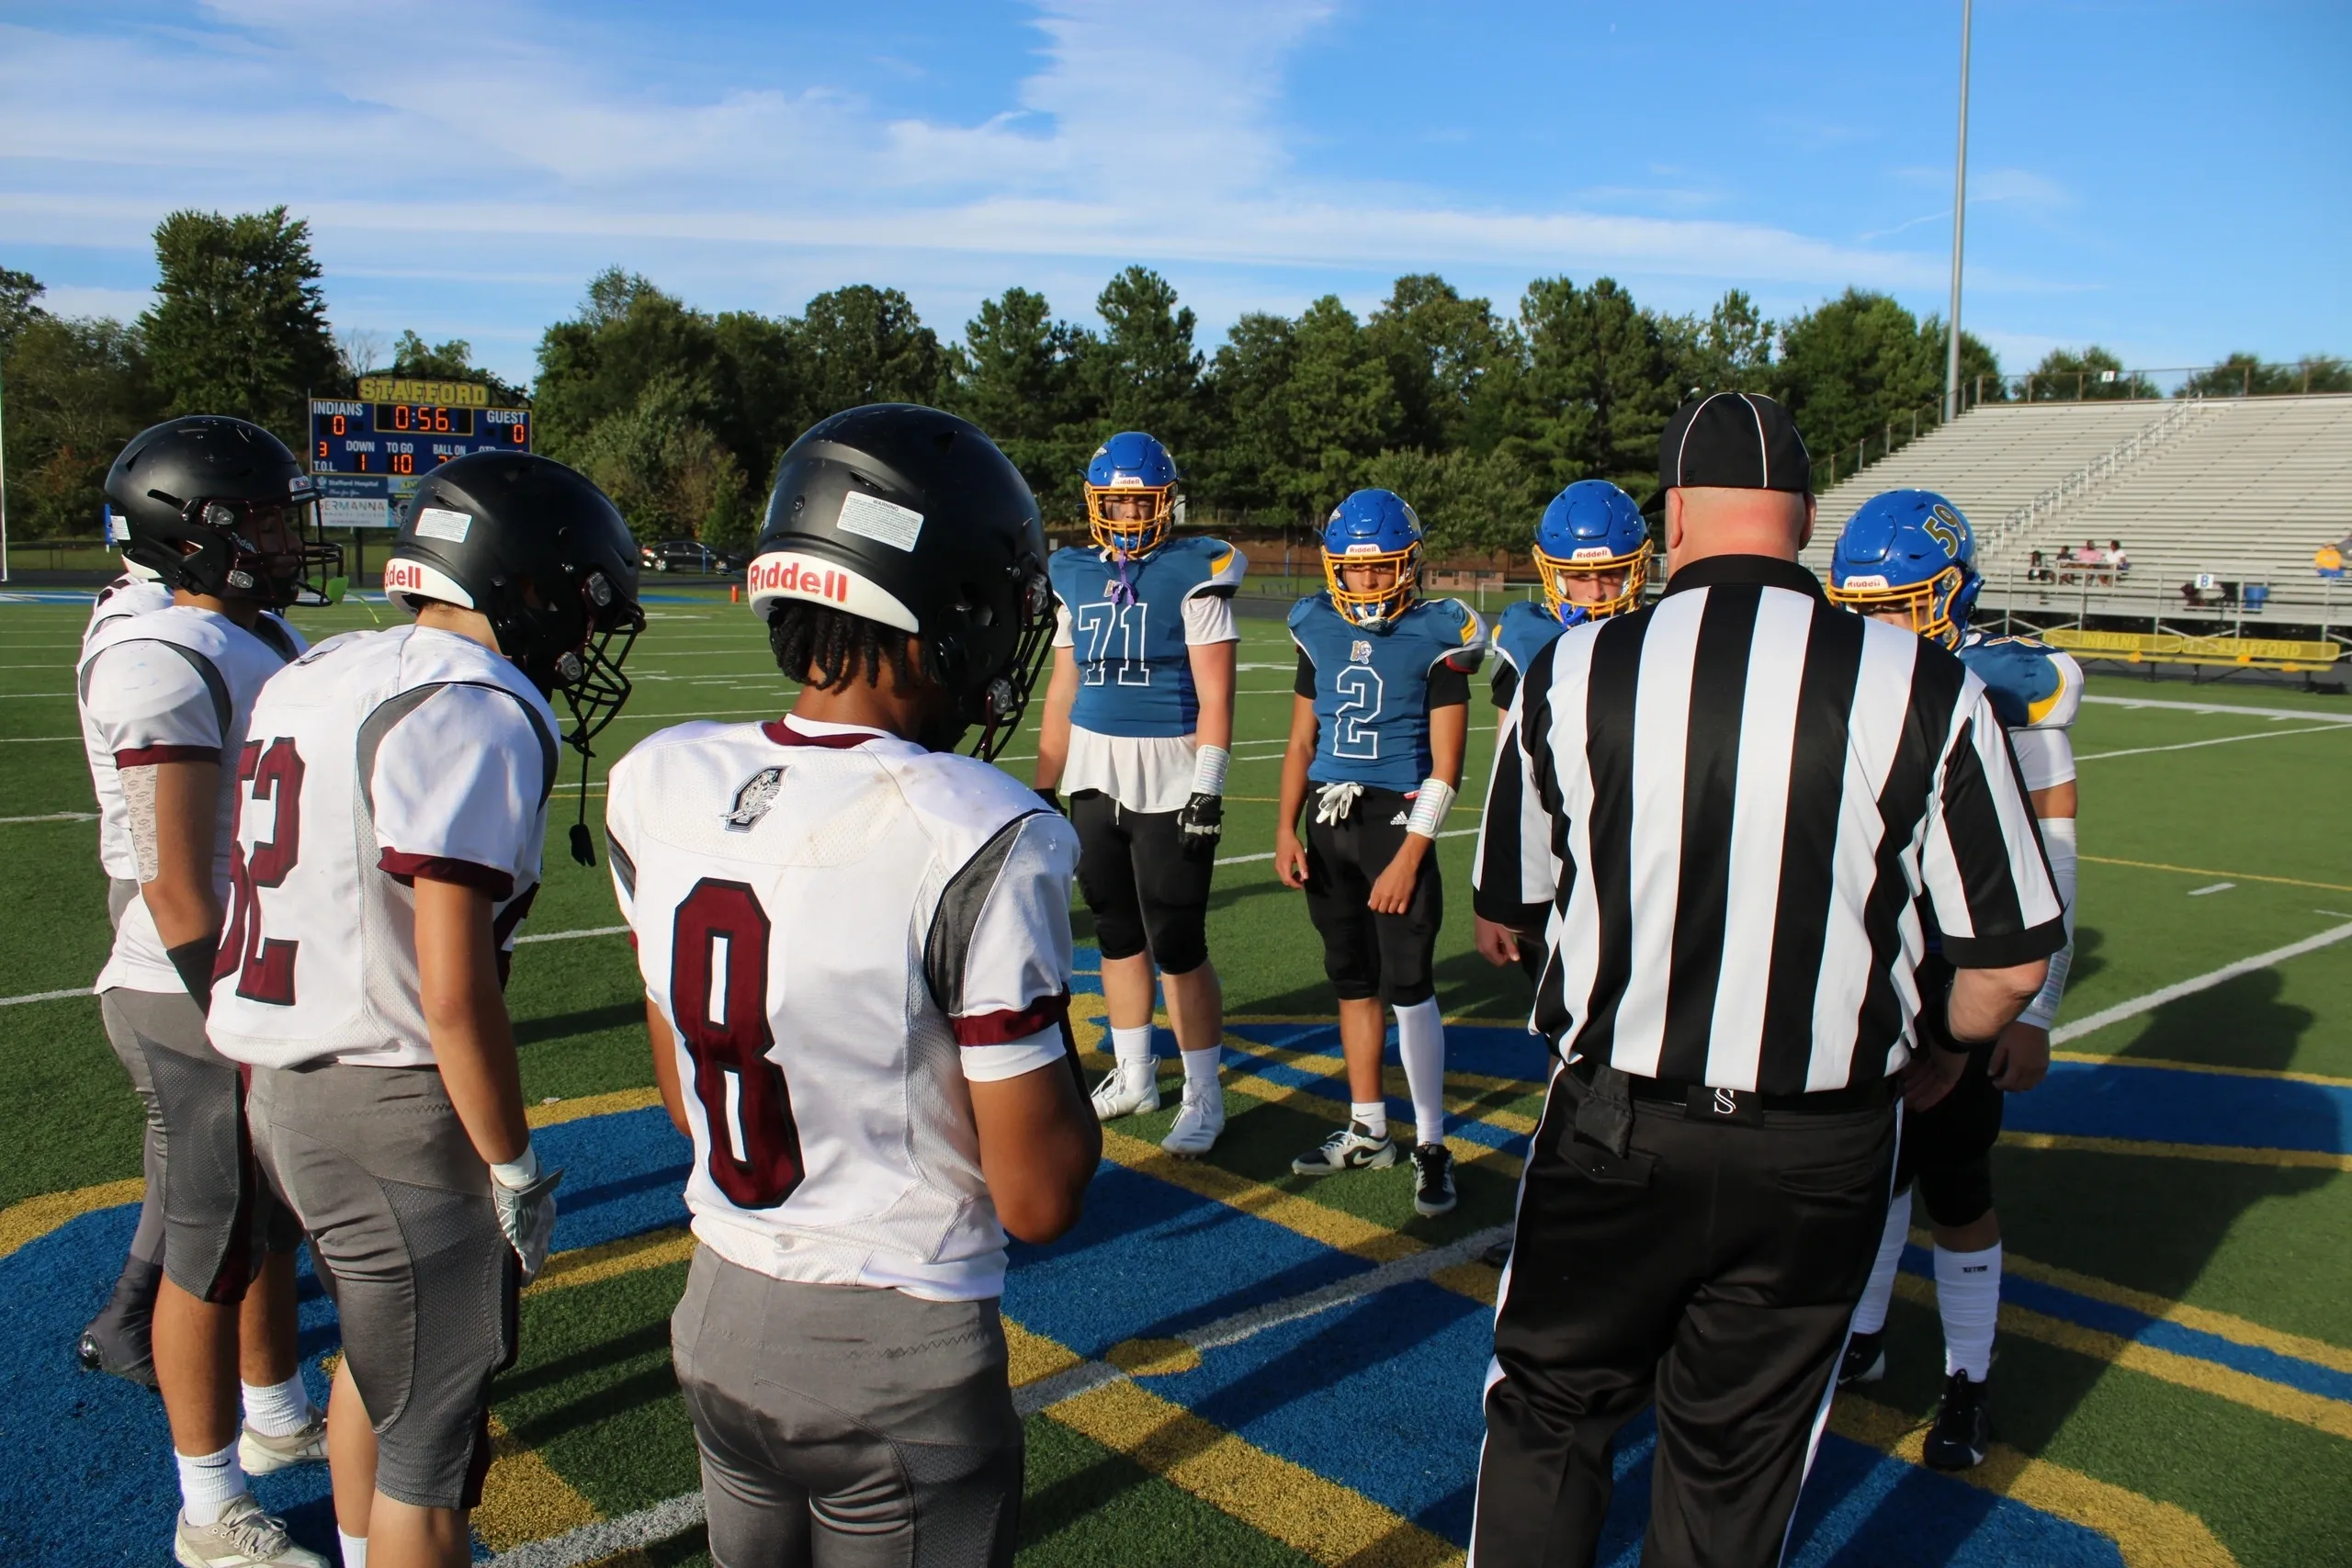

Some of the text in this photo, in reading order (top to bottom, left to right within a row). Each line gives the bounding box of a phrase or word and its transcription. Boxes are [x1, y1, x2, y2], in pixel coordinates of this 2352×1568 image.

[358, 378, 488, 405] STAFFORD
[313, 400, 363, 416] INDIANS
[487, 410, 526, 423] GUEST
[334, 415, 345, 435] 0
[514, 424, 525, 443] 0
[319, 441, 327, 457] 3
[345, 441, 375, 452] DOWN
[386, 442, 413, 453] TO GO
[433, 444, 453, 455] BALL
[454, 445, 466, 456] ON
[361, 454, 366, 470] 1
[394, 455, 412, 473] 10
[873, 499, 899, 512] WARNING
[1922, 504, 1967, 559] 59
[1577, 549, 1607, 558] Riddell
[750, 561, 848, 603] Riddell
[1079, 602, 1150, 686] 71
[2081, 633, 2141, 649] INDIANS
[2215, 639, 2301, 656] STAFFORD
[1332, 665, 1384, 759] 2
[671, 877, 806, 1209] 8
[1713, 1088, 1736, 1114] S
